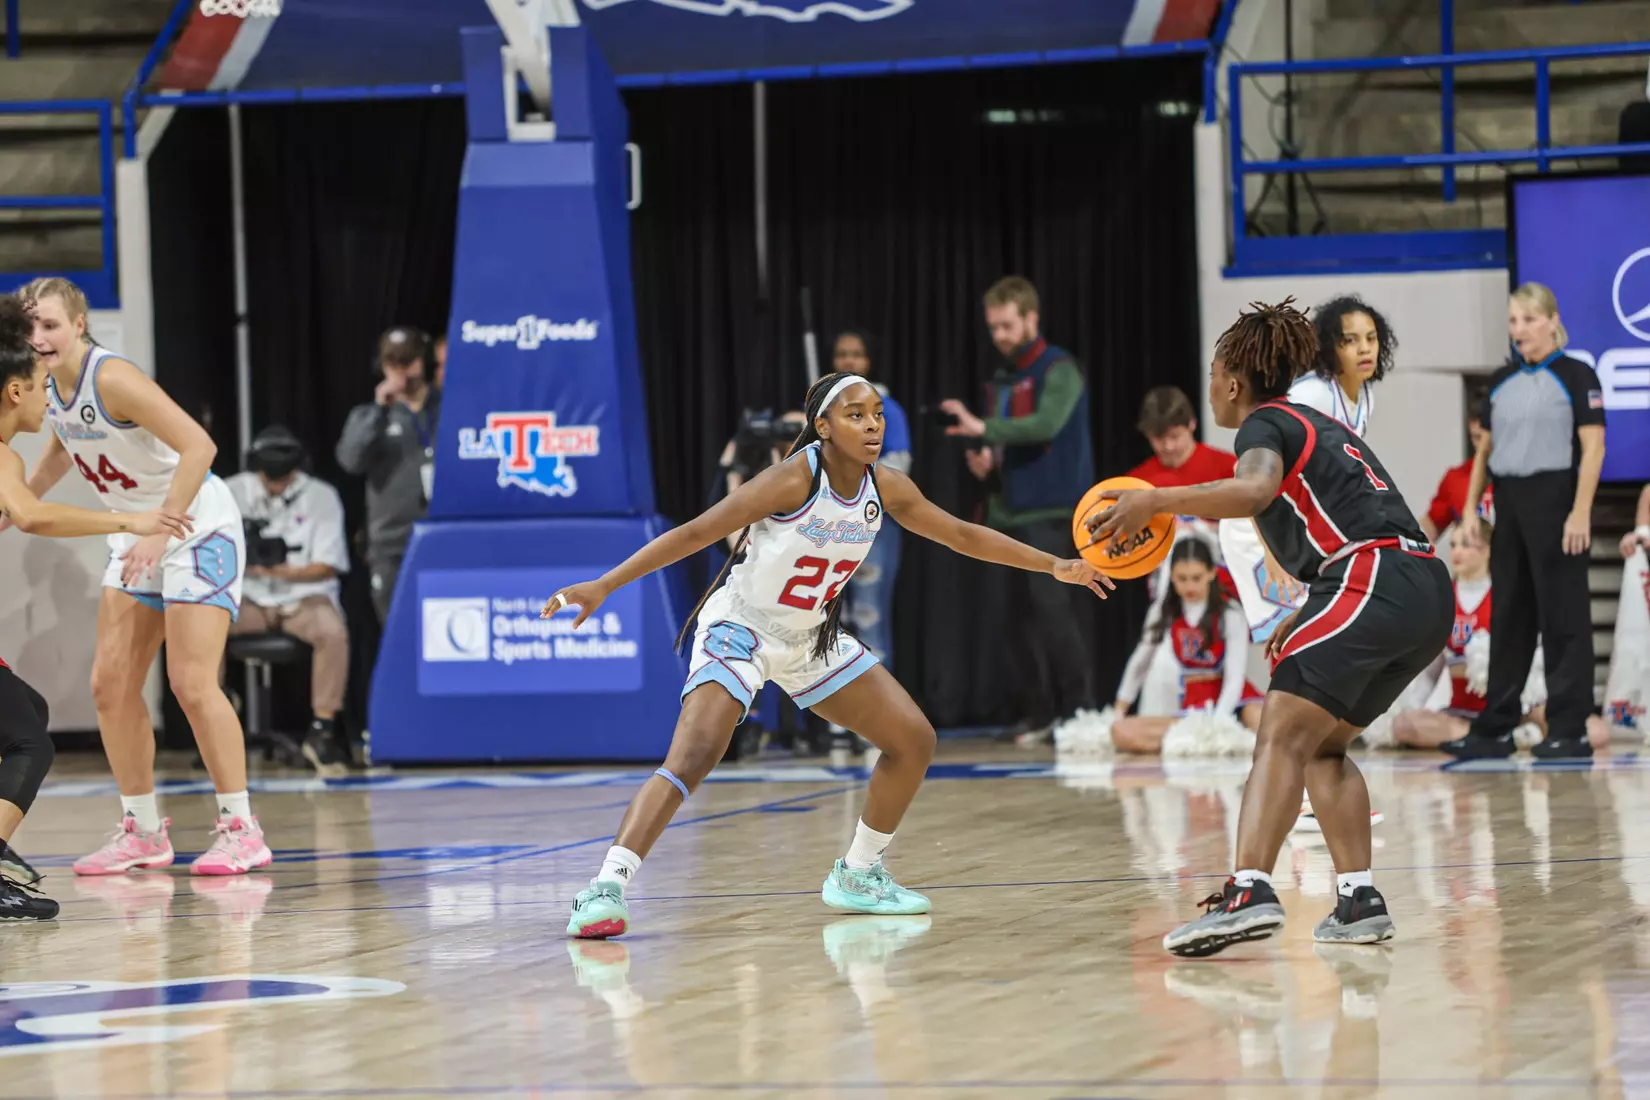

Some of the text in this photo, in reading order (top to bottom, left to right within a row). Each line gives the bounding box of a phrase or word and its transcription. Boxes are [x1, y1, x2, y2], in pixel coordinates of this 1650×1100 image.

[461, 319, 516, 347] Super
[536, 317, 598, 341] Foods
[458, 427, 503, 459] LA
[73, 452, 138, 493] 44
[1343, 443, 1389, 491] 1
[796, 515, 833, 548] Lady
[1108, 527, 1154, 559] NCAA
[777, 555, 861, 613] 22
[602, 611, 622, 636] &
[492, 637, 638, 665] Sports Medicine
